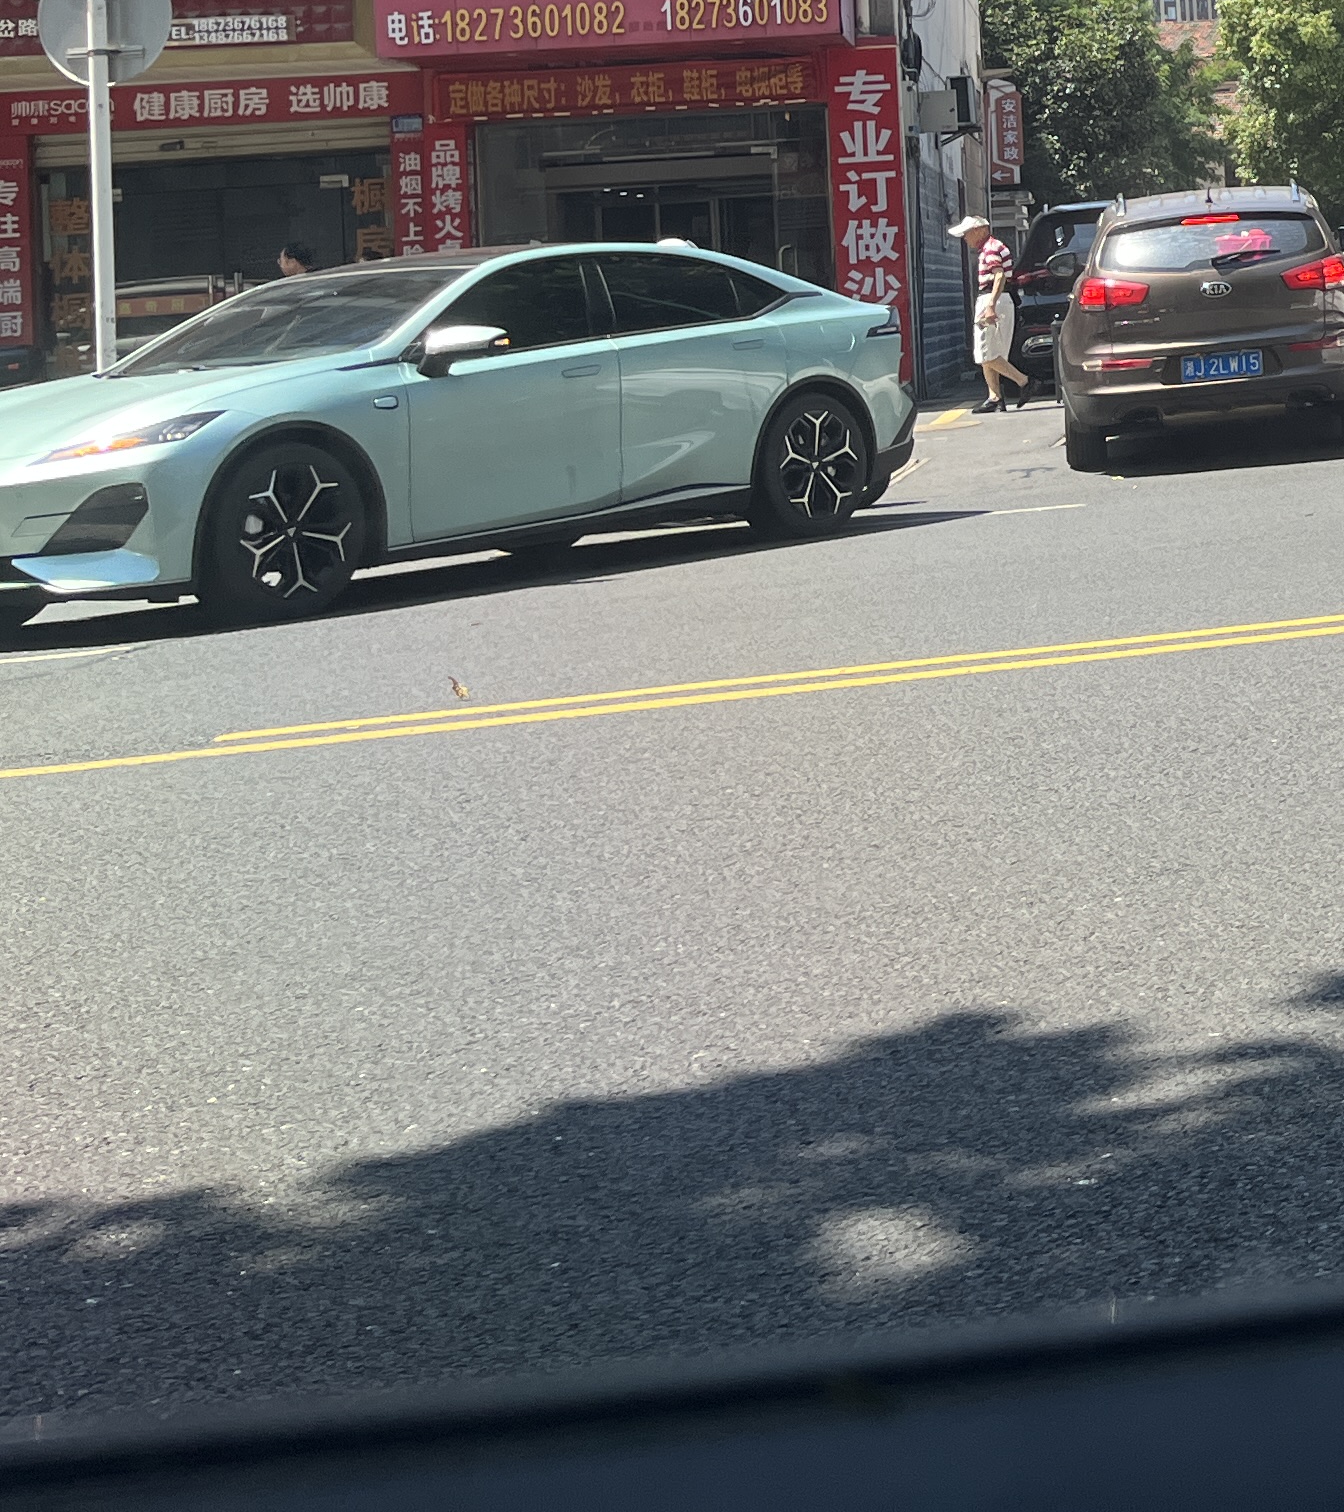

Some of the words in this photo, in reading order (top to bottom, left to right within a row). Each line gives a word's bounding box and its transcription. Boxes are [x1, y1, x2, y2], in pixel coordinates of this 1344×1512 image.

[194, 15, 287, 31] 18673676168
[194, 29, 288, 43] 13487667168
[133, 87, 270, 122] 健康厨房
[288, 80, 390, 114] 选帅康
[1001, 99, 1020, 161] 安洁家政
[1203, 282, 1231, 297] KIA
